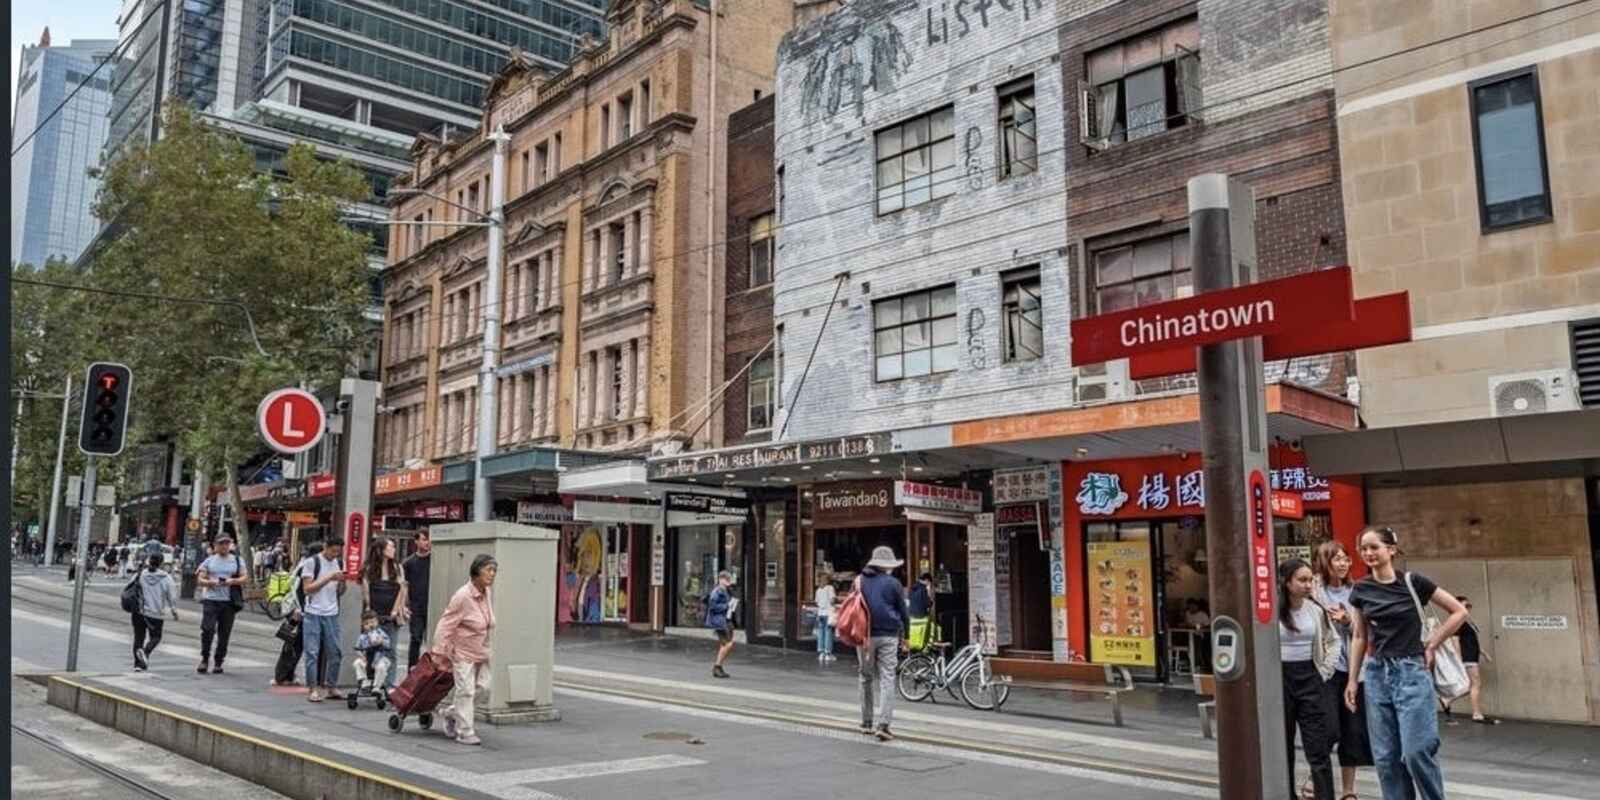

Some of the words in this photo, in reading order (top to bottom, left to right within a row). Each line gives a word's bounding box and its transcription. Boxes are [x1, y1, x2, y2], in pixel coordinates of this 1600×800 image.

[1120, 298, 1275, 347] Chinatown
[282, 402, 305, 438] L
[732, 446, 800, 468] RESTAURANT
[816, 489, 888, 510] Tawandang
